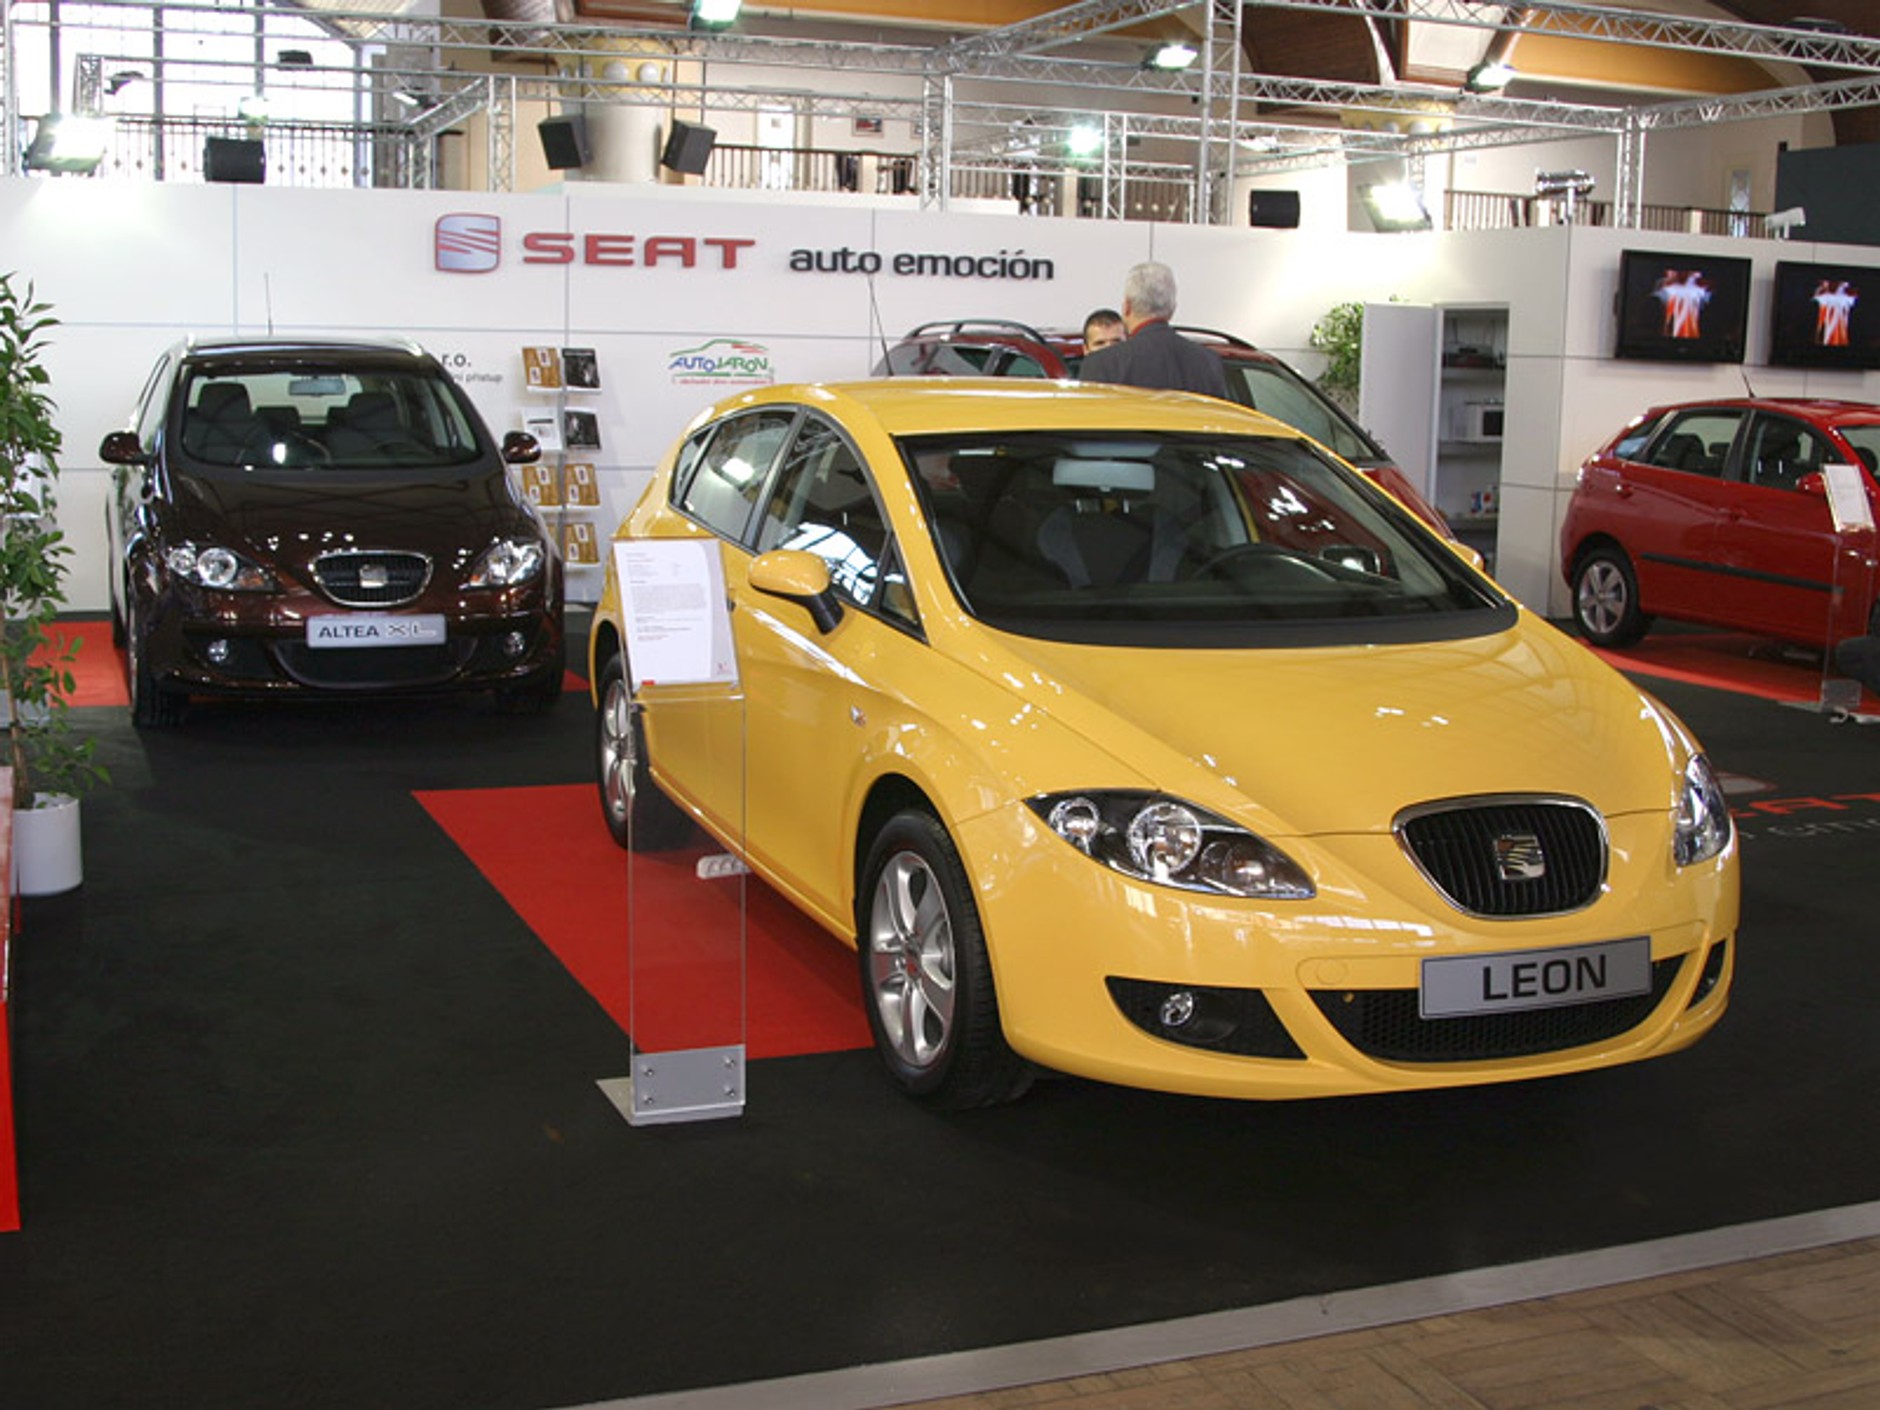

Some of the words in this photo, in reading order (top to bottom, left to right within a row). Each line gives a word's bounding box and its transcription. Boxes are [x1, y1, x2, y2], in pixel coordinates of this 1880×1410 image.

[522, 232, 756, 269] SEAT
[789, 247, 882, 274] auto
[893, 250, 1054, 280] emoción
[318, 625, 380, 639] ALTEA
[1482, 954, 1606, 1001] LEON
